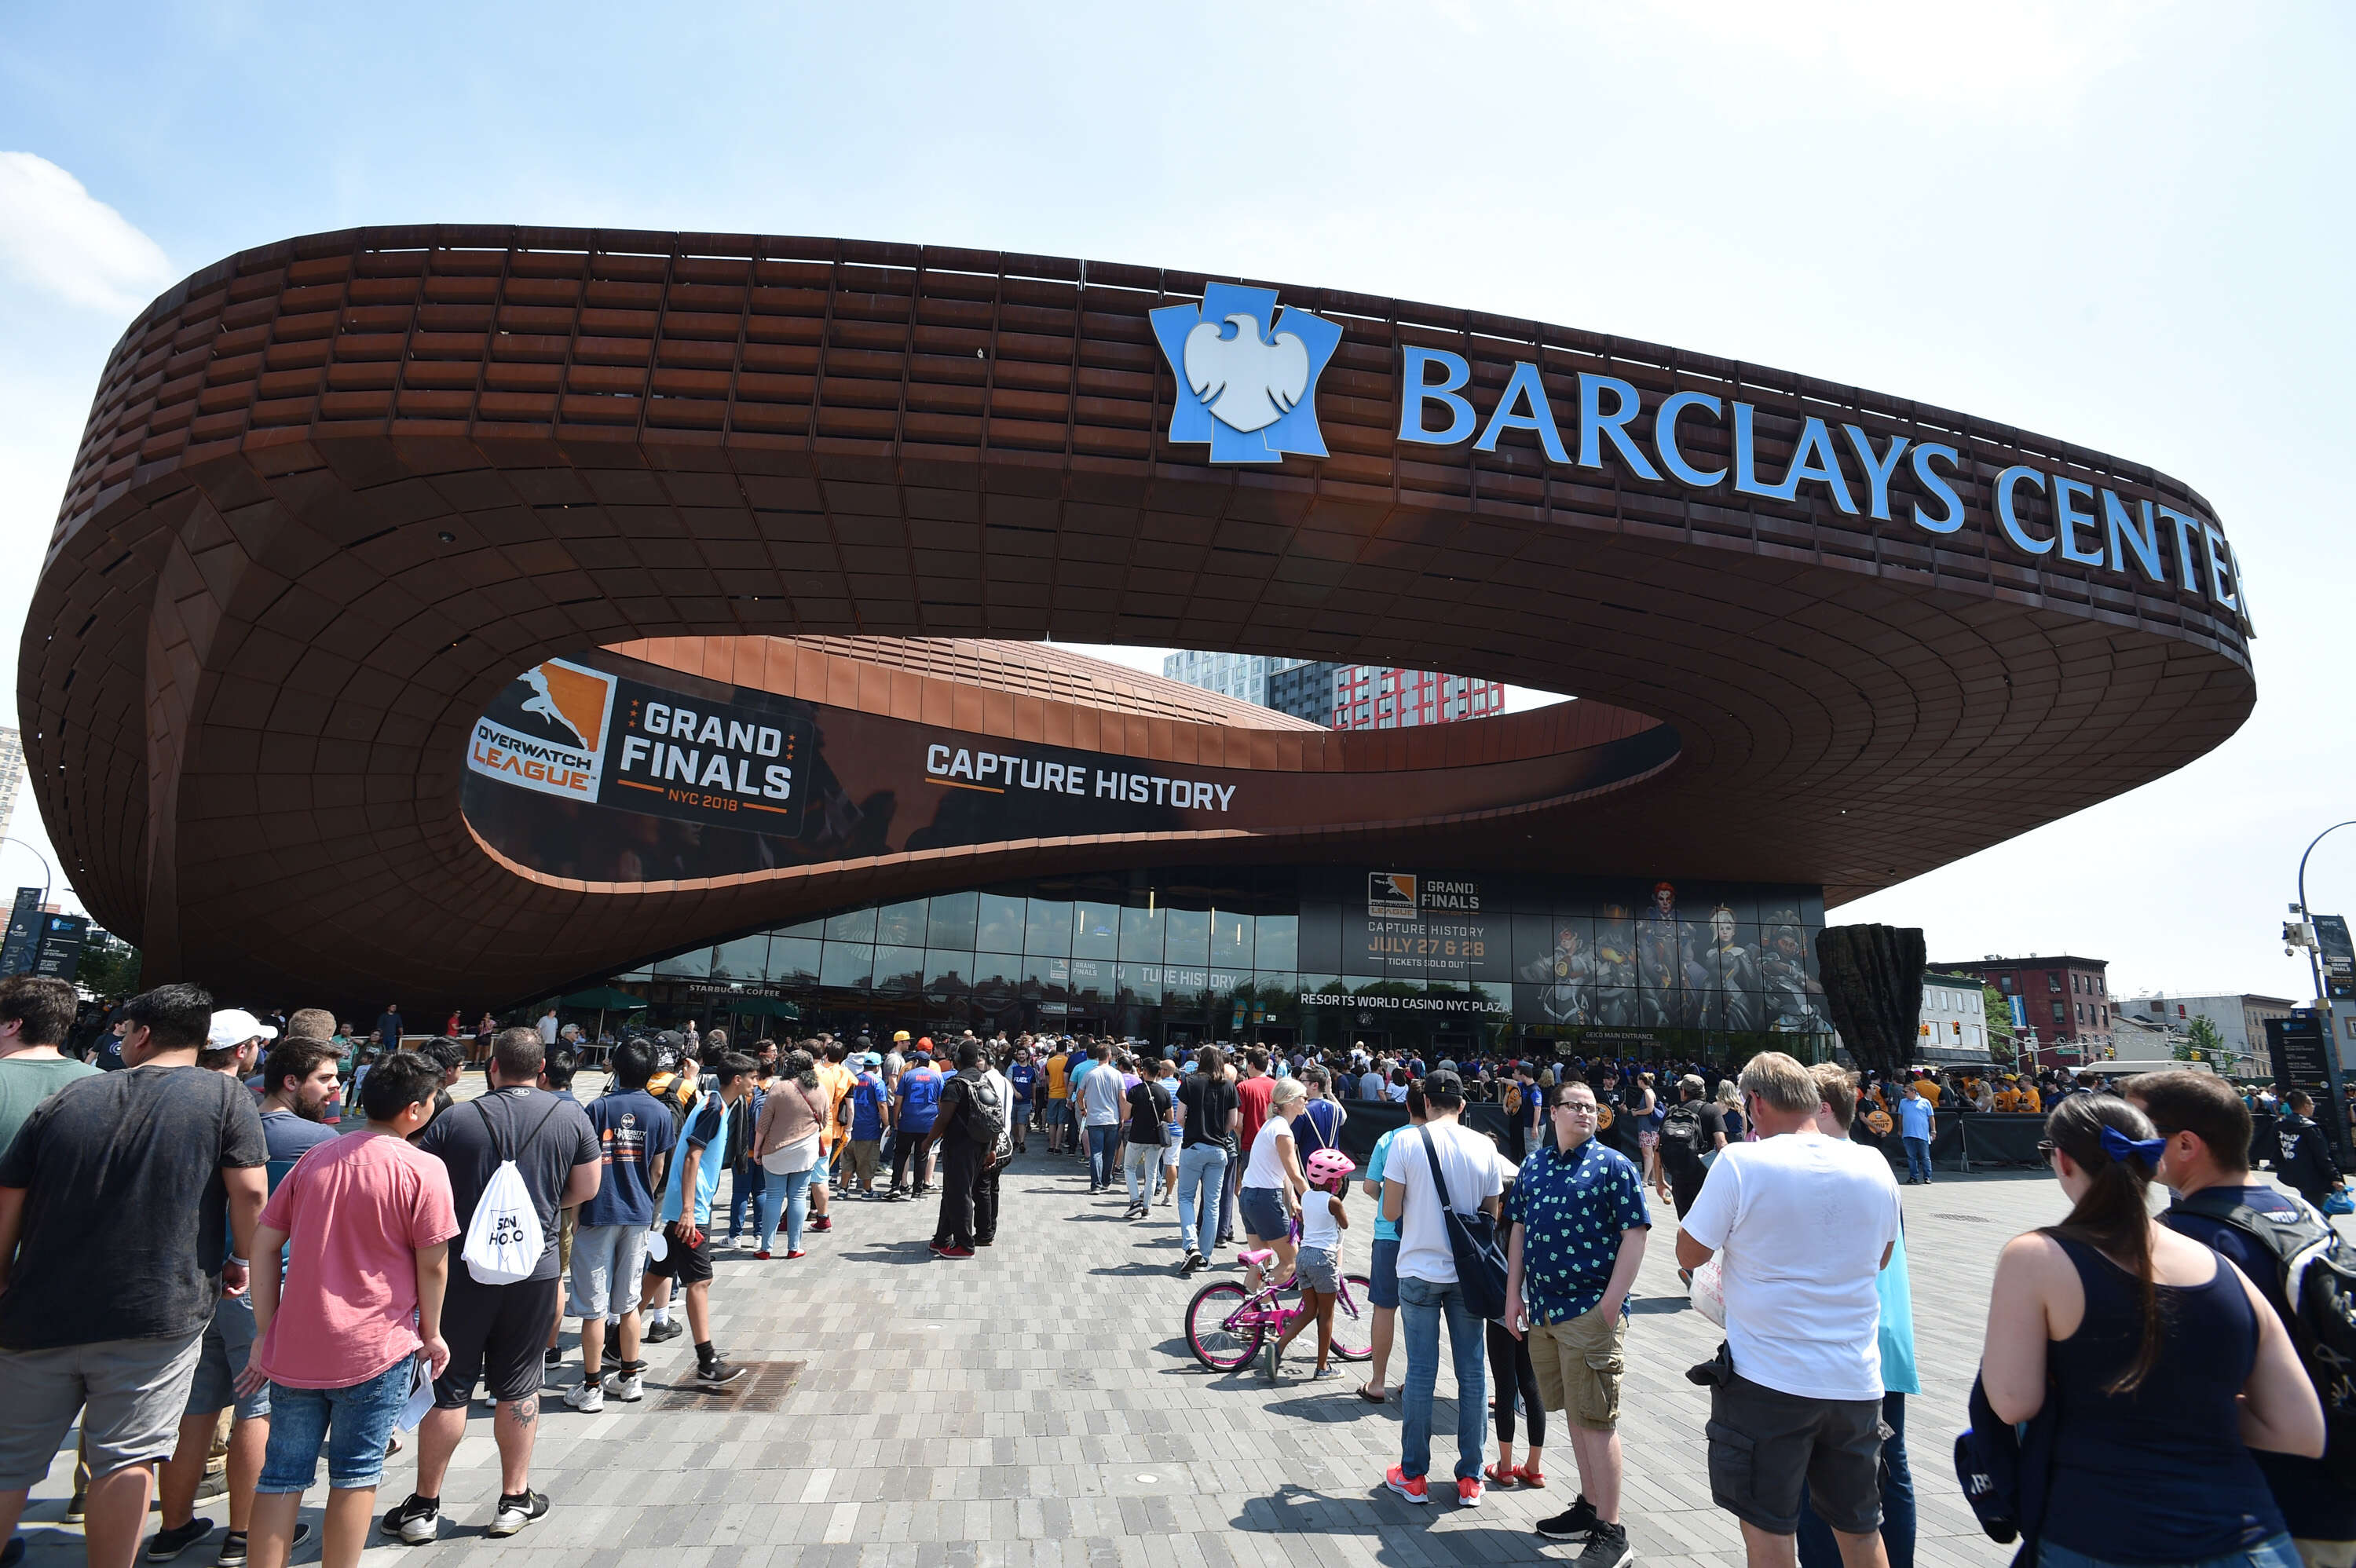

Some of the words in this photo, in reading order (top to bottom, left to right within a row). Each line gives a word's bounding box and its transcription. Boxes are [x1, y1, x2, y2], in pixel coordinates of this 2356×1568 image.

[1398, 345, 1965, 535] BARCLAYS
[1991, 465, 2258, 639] CENTER
[644, 701, 782, 758] GRAND
[477, 724, 592, 770] OVERWATCH
[473, 740, 589, 791] LEAGUE
[620, 734, 792, 800] FINALS
[926, 743, 1087, 796] CAPTURE
[1095, 769, 1237, 813] HISTORY
[668, 789, 699, 806] NYC
[703, 794, 739, 812] 2018
[1427, 880, 1474, 894] GRAND
[1421, 894, 1480, 909] FINALS
[1371, 907, 1414, 916] LEAGUE
[1368, 921, 1425, 934] CAPTURE
[1431, 925, 1484, 938] HISTORY
[1368, 936, 1412, 954] JULY
[1418, 938, 1440, 954] 27
[1444, 941, 1457, 956] &
[1462, 941, 1484, 957] 28
[1073, 968, 1098, 977] FINALS
[1388, 958, 1422, 967] TICKETS
[1424, 959, 1447, 968] SOLD
[1448, 960, 1465, 969] OUT
[1180, 970, 1238, 989] HISTORY
[690, 985, 744, 994] STARBUCKS
[746, 989, 781, 997] COFFEE
[1301, 993, 1355, 1007] RESORTS
[1357, 996, 1399, 1009] WORLD
[1402, 998, 1443, 1011] CASINO
[1446, 1000, 1469, 1012] NYC
[1472, 1001, 1510, 1013] PLAZA
[1604, 1032, 1620, 1040] MAIN
[497, 1215, 517, 1230] SAN
